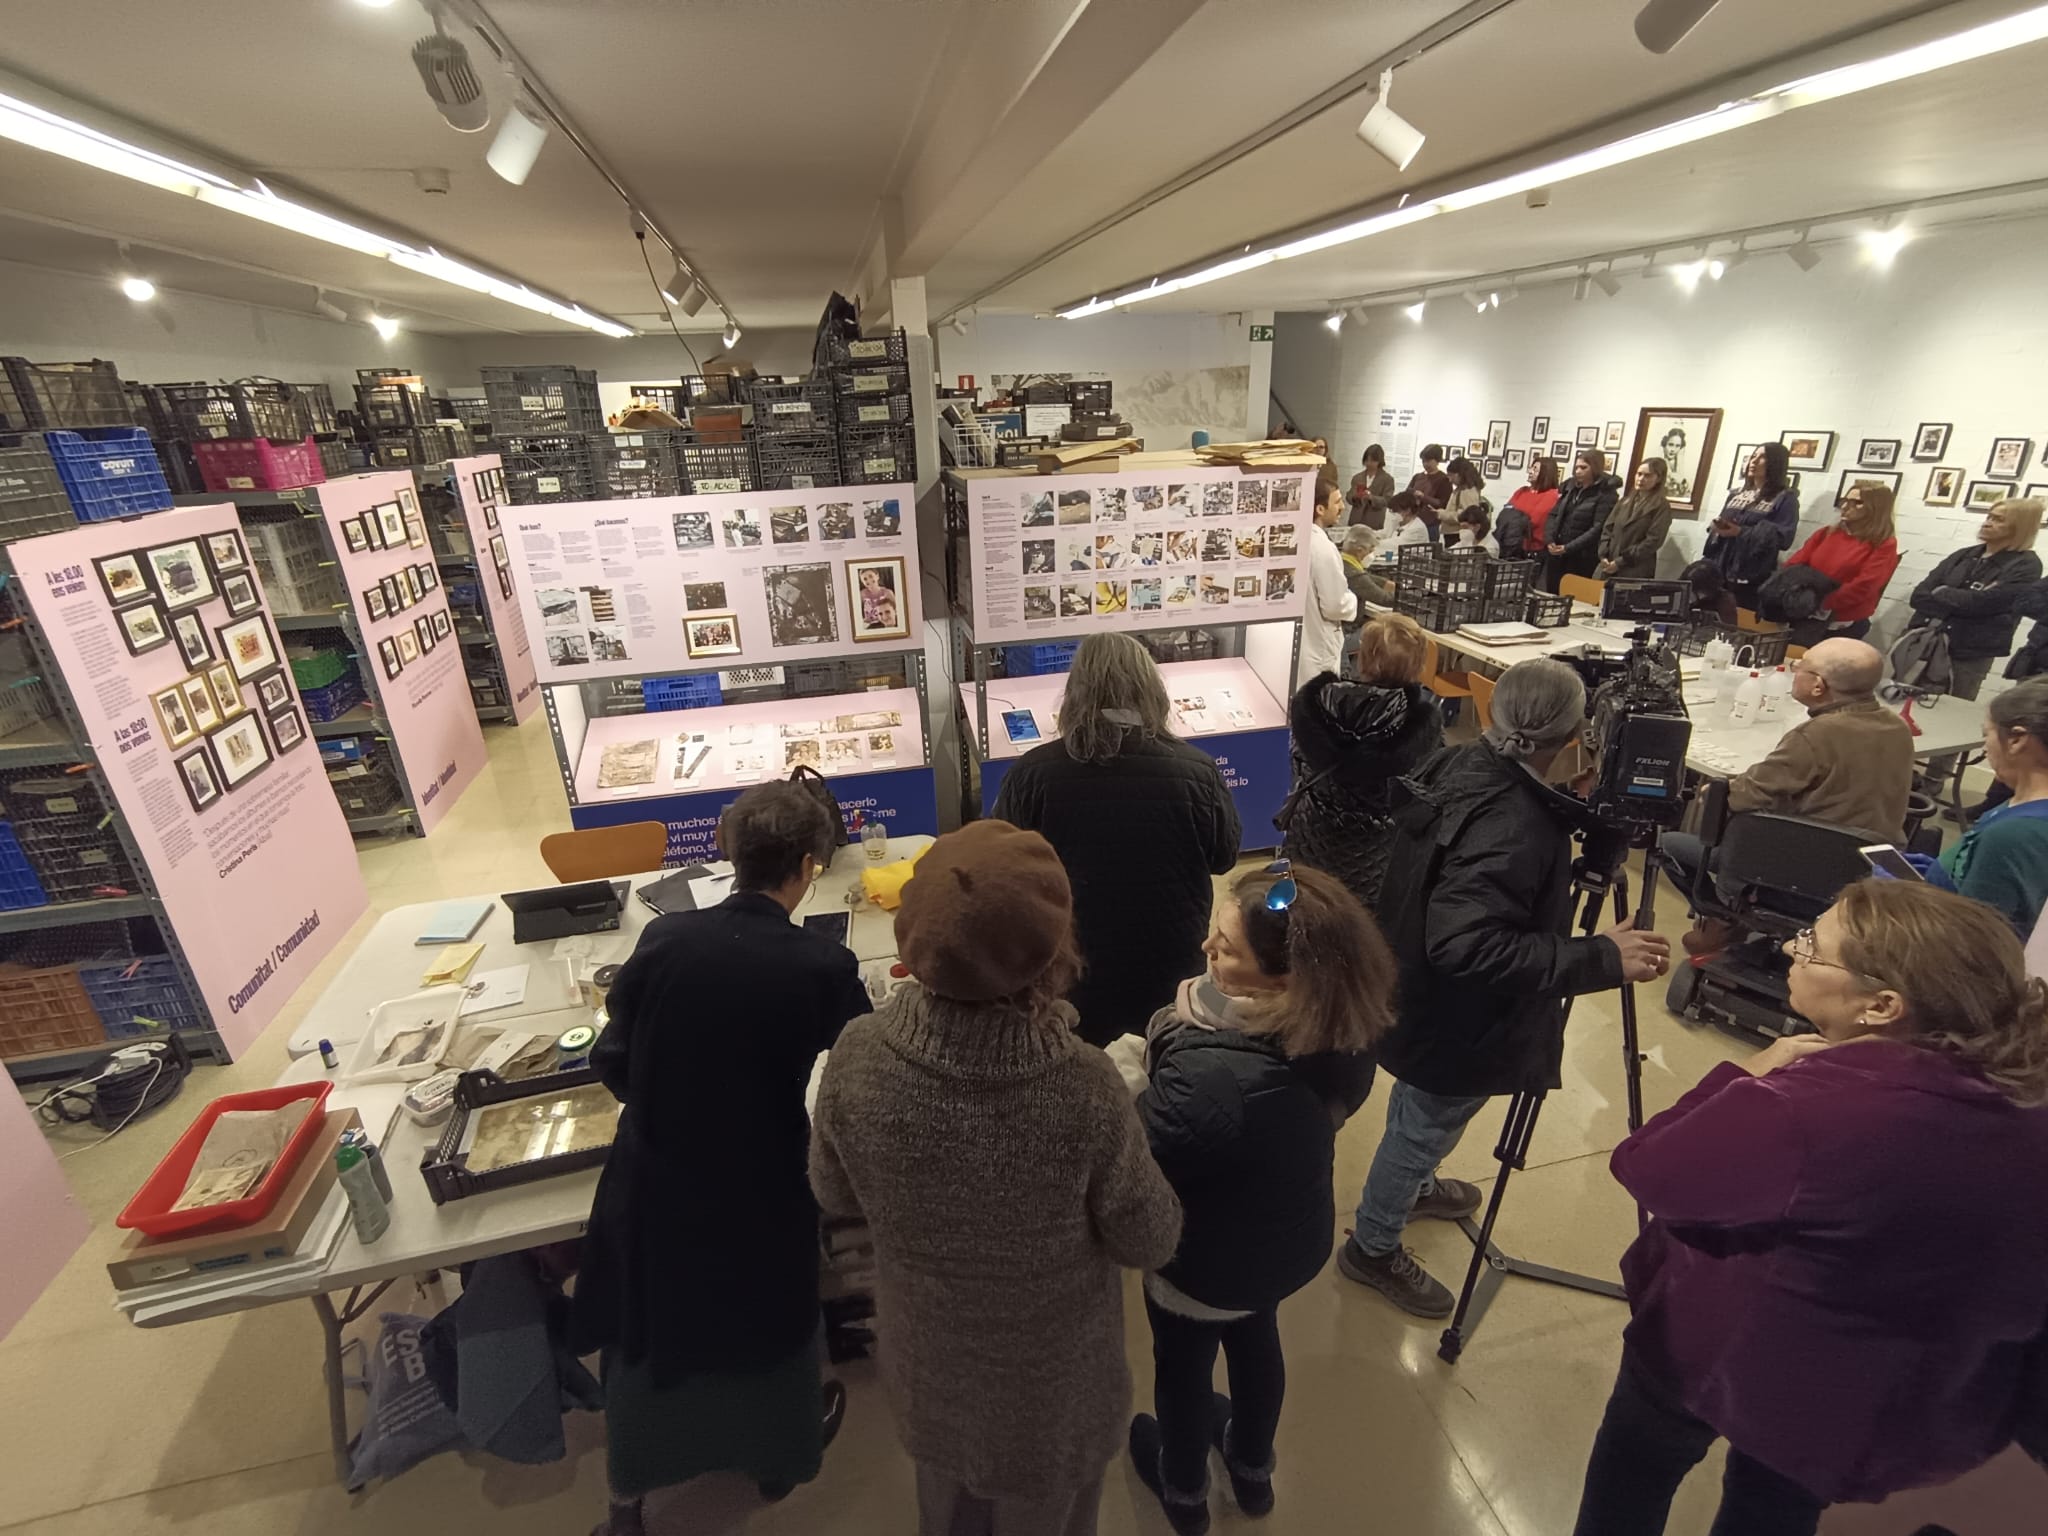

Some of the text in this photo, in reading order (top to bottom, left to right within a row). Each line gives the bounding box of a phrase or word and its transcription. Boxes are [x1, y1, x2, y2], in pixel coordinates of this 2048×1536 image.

[668, 817, 716, 830] muchos
[682, 831, 707, 842] muy
[228, 958, 274, 1014] Comunitat
[275, 909, 320, 962] Comunidad
